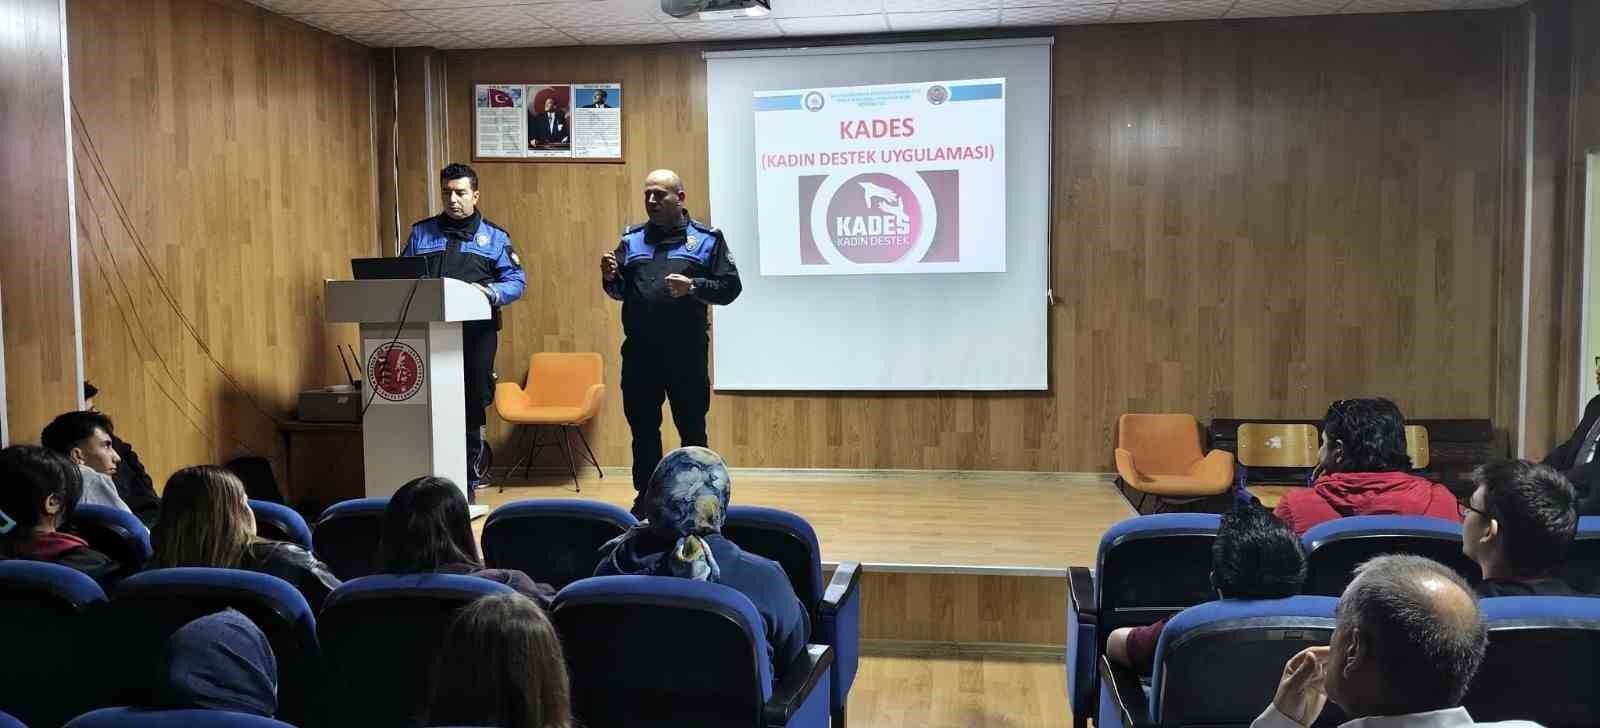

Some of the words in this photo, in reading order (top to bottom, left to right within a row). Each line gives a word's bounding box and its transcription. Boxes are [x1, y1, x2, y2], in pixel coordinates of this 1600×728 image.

[840, 118, 915, 140] KADES
[762, 153, 815, 170] (KADIN
[820, 150, 876, 166] DESTEK
[882, 144, 995, 163] UYGULAMASI)
[837, 215, 910, 236] KADES
[837, 236, 868, 247] KADIN
[870, 236, 910, 247] DESTEK
